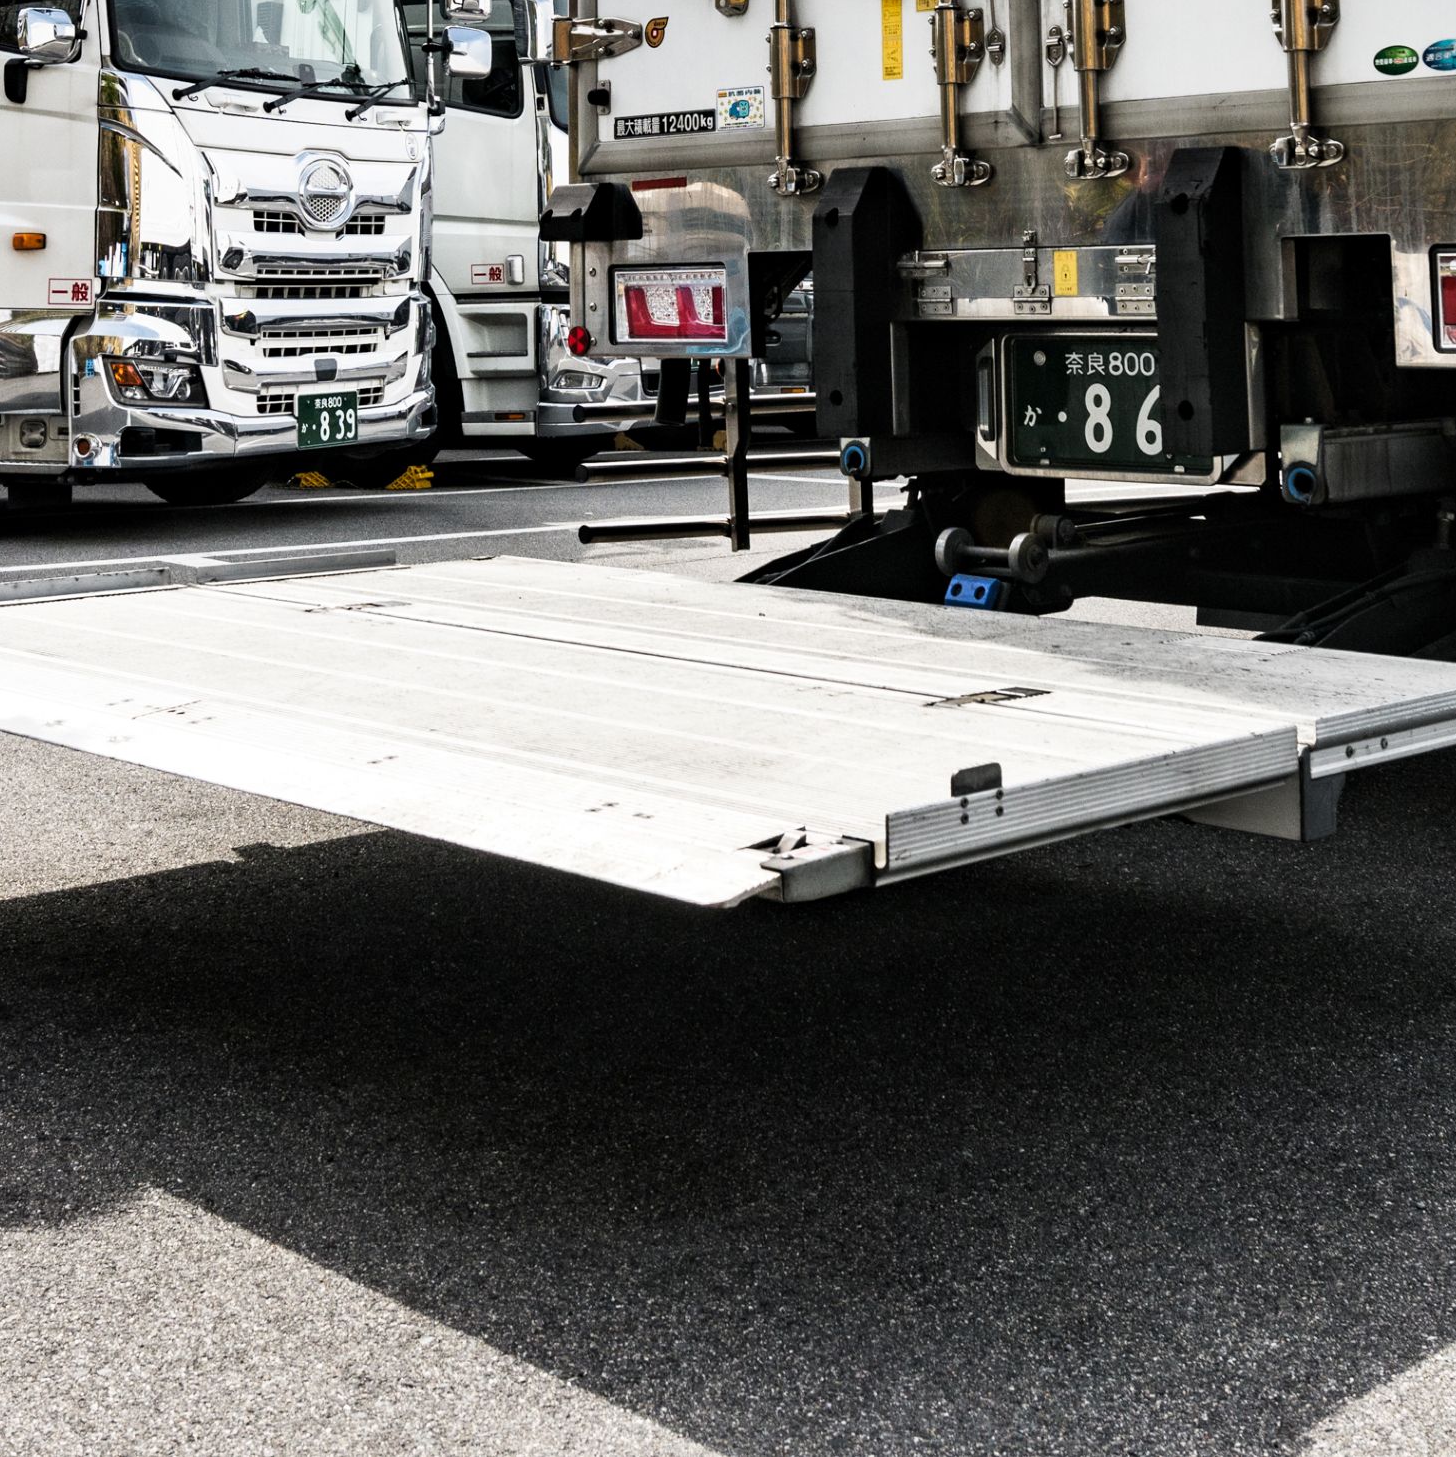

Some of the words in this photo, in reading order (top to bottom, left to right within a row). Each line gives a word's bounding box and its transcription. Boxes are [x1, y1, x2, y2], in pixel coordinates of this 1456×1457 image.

[616, 116, 660, 137] 最大積載量
[661, 113, 714, 133] 12400kg
[474, 266, 503, 282] 一般
[51, 282, 89, 302] 一般
[1023, 405, 1043, 427] か
